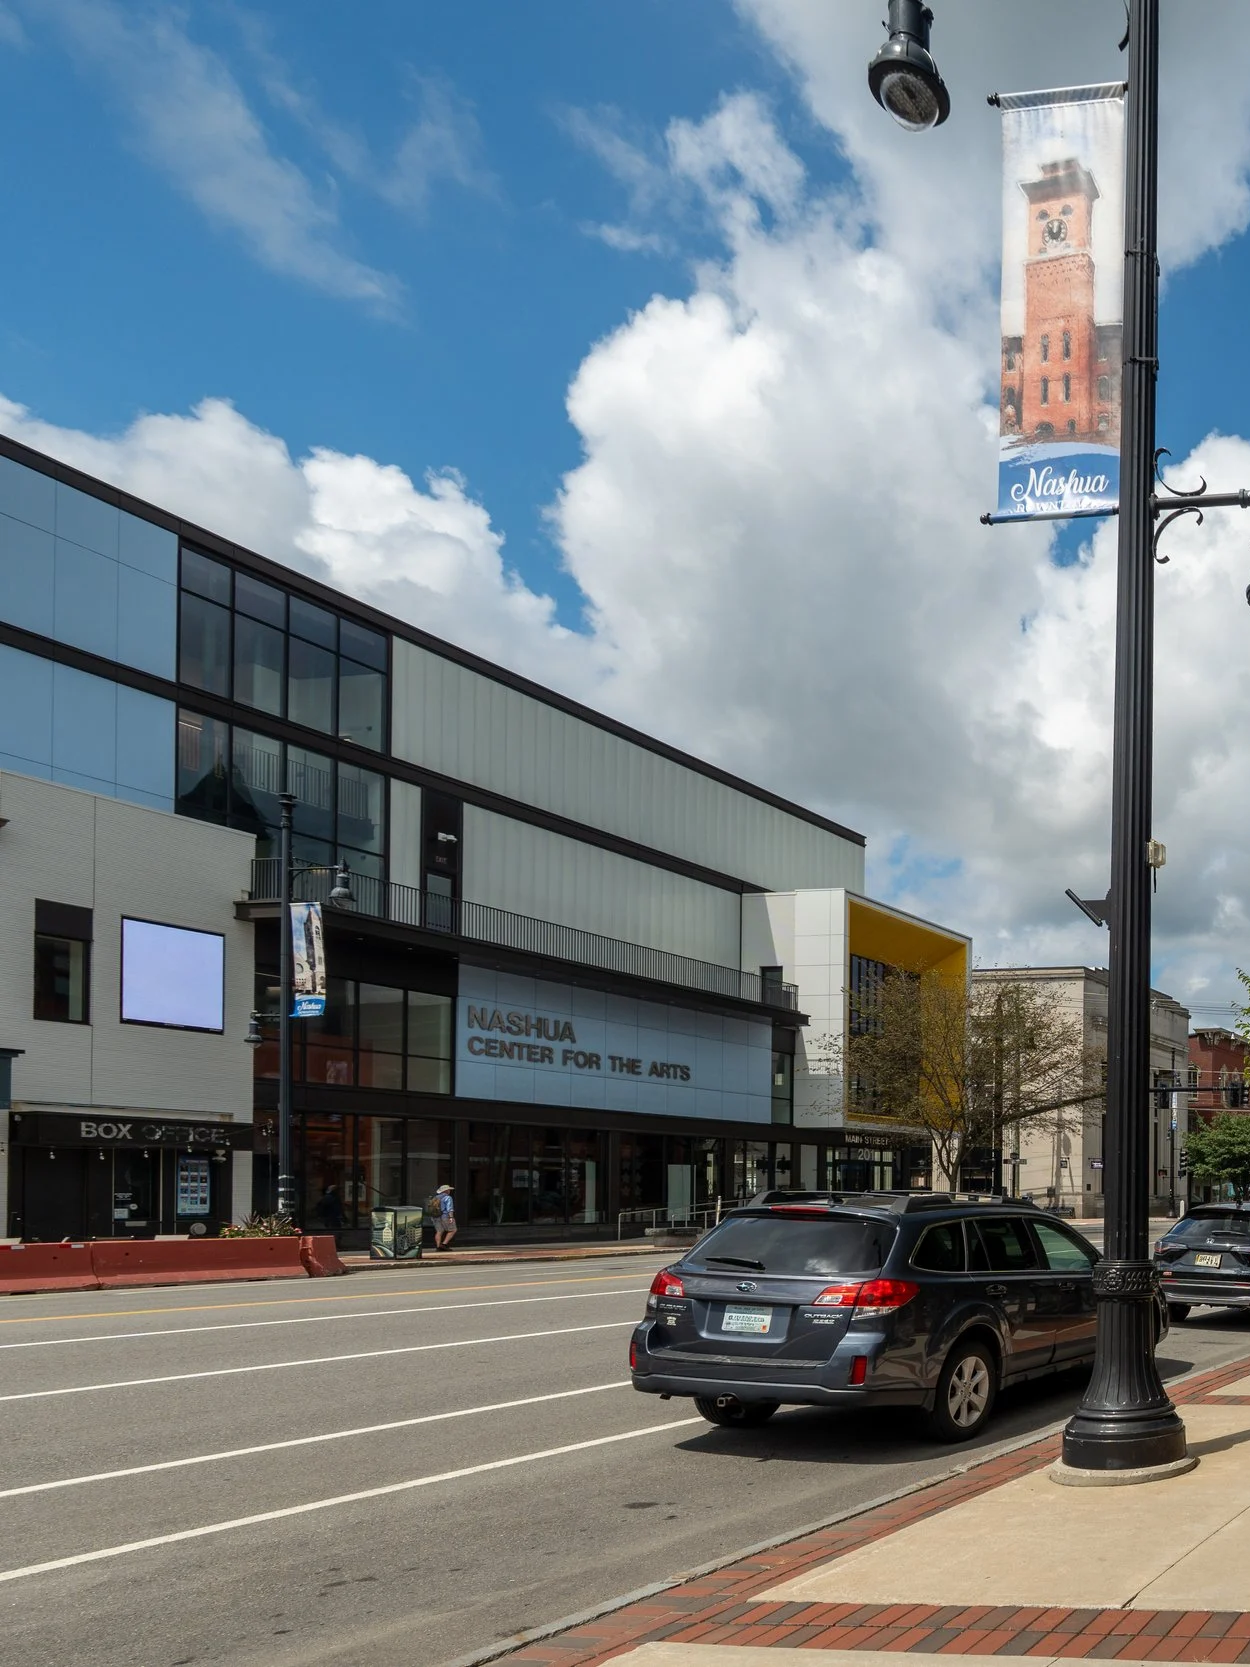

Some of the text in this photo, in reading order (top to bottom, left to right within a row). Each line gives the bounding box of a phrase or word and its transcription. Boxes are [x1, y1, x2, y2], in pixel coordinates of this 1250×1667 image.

[1010, 466, 1110, 502] Nashua
[467, 1005, 577, 1044] NASHUA
[467, 1036, 692, 1082] CENTER FOR THE ARTS
[80, 1121, 225, 1144] BOX OFFICE
[845, 1134, 889, 1146] MAIN STREET
